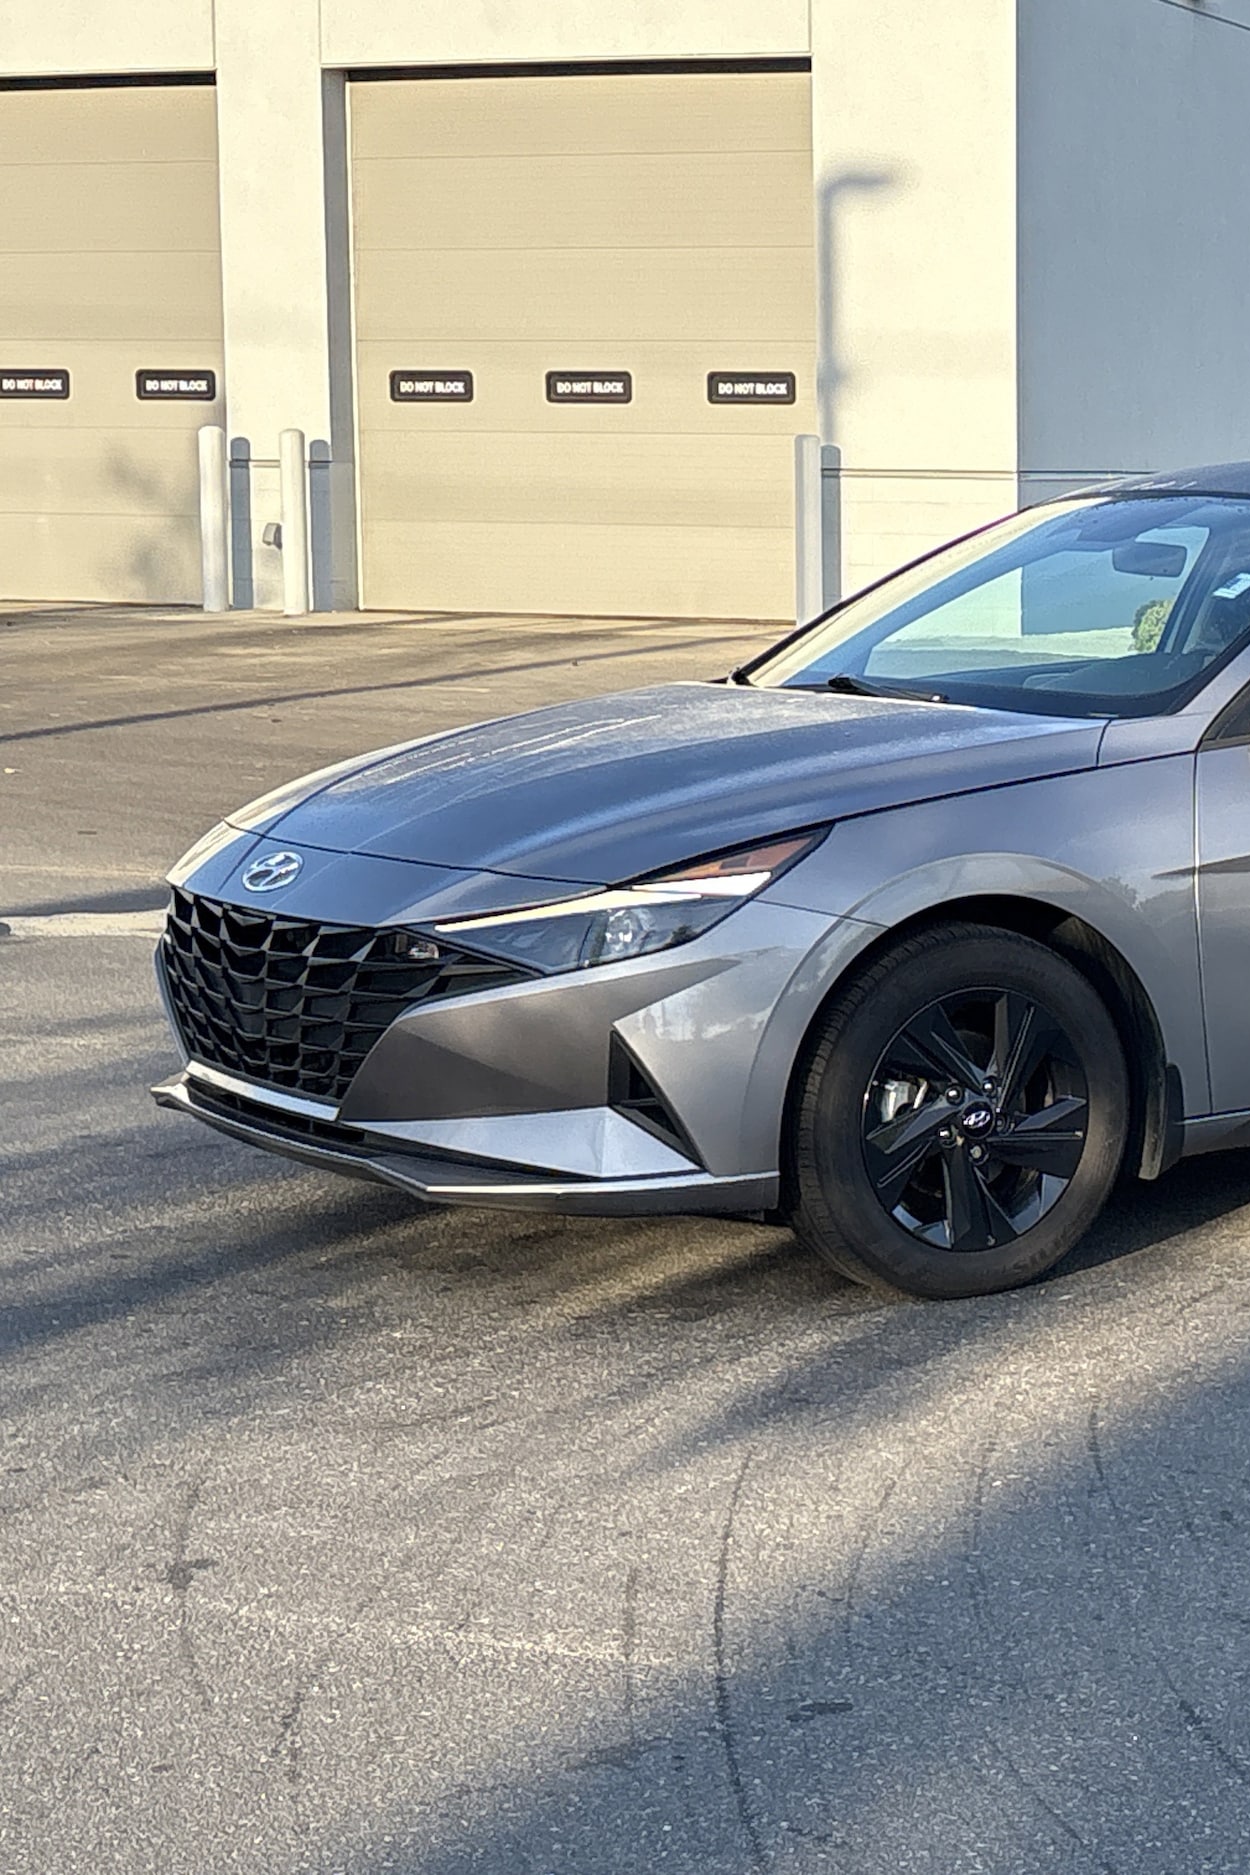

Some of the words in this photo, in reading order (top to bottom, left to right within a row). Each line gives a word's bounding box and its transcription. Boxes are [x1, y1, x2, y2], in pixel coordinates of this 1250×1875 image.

[2, 379, 15, 390] DO
[16, 379, 34, 390] NOT
[35, 379, 62, 390] BLOCK
[146, 380, 159, 391] DO
[160, 380, 177, 391] NOT
[179, 380, 207, 391] BLOCK
[400, 381, 414, 393] DO
[415, 381, 433, 393] NOT
[435, 381, 464, 393] BLOCK
[557, 381, 571, 393] DO
[572, 381, 591, 393] NOT
[593, 381, 623, 393] BLOCK
[718, 382, 733, 394] DO
[734, 382, 754, 394] NOT
[755, 382, 787, 394] BLOCK
